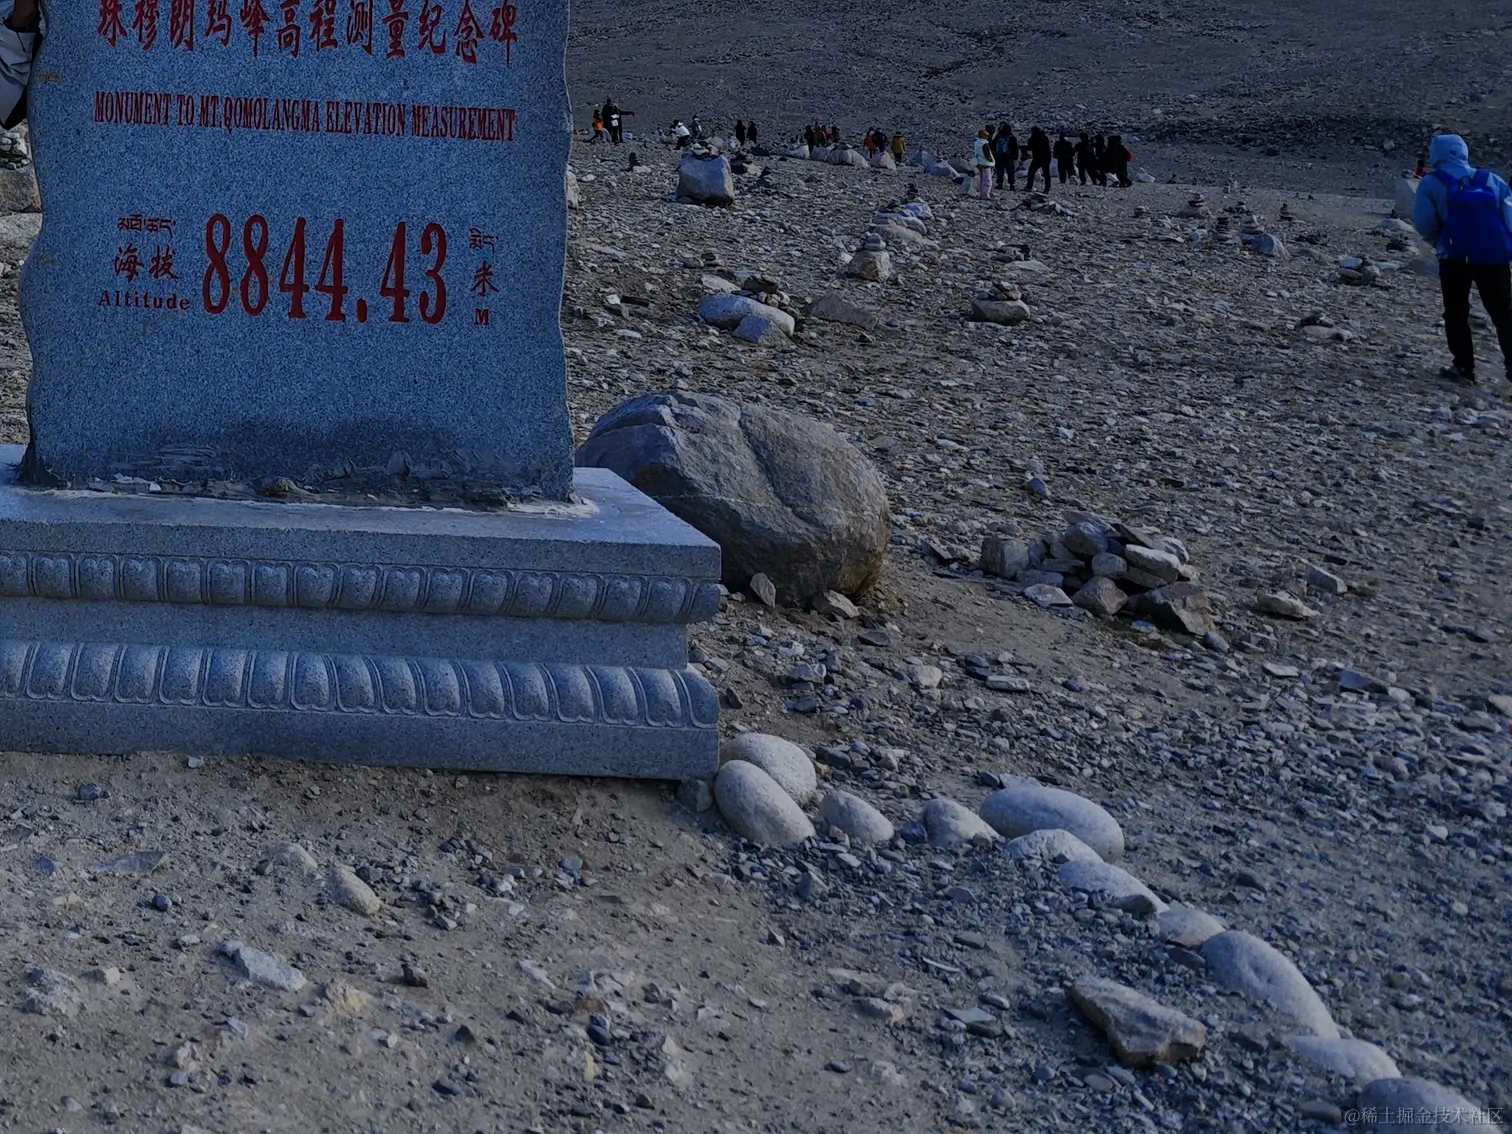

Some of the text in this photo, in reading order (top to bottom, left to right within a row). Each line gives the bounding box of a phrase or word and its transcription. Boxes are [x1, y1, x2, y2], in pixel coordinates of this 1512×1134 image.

[94, 90, 172, 126] MONUMENT
[176, 94, 195, 127] TO
[326, 100, 406, 137] ELEVATION
[411, 105, 516, 141] MEASUREMENT
[114, 242, 179, 283] 海拔
[201, 213, 448, 325] 8844.43
[470, 260, 499, 297] 米
[97, 290, 191, 310] Altitude
[474, 308, 490, 325] M
